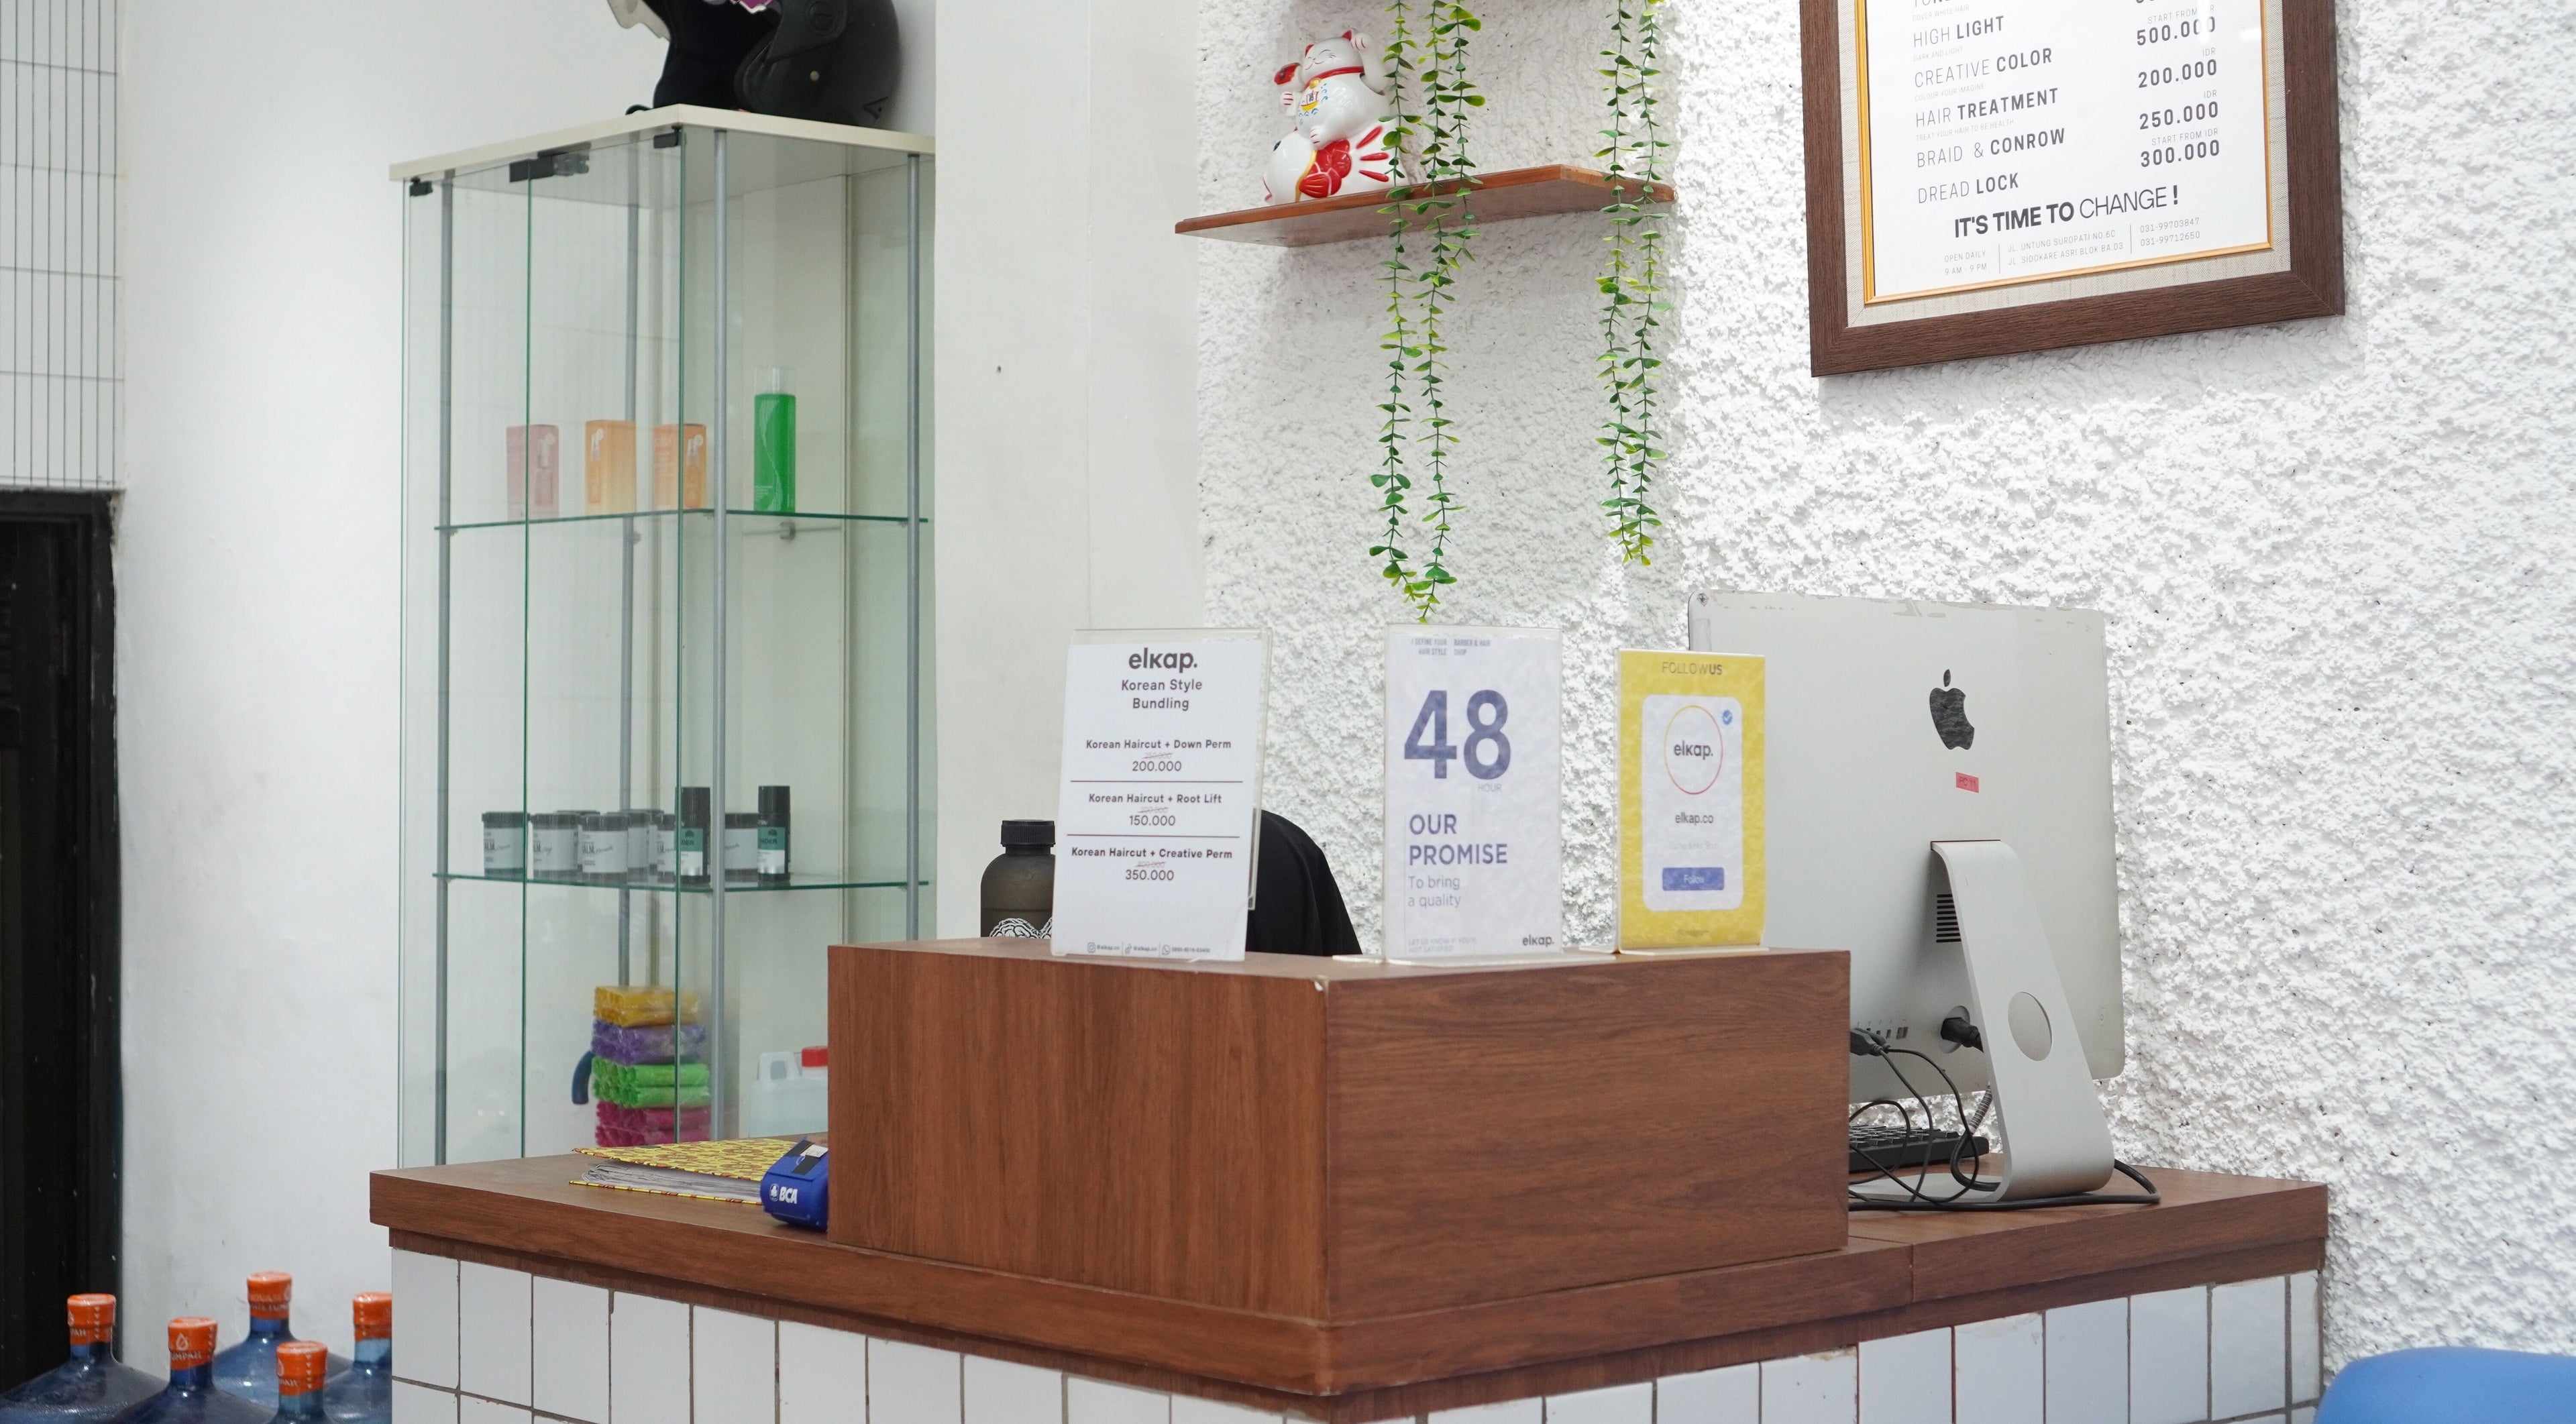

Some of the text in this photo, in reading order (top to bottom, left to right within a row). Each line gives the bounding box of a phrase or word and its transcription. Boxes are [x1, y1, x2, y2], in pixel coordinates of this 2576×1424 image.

[2148, 13, 2172, 24] START
[2176, 8, 2198, 19] FROM
[1913, 15, 2004, 48] HIGH LIGHT
[2202, 47, 2216, 56] IDR
[1915, 48, 2052, 88] CREATIVE COLOR
[2138, 58, 2216, 88] 200.000
[1915, 83, 1985, 102] COLOUR YOUR IMAGINE
[2204, 89, 2217, 99] IDR
[1916, 87, 2058, 128] HAIR TREATMENT
[2139, 101, 2218, 129] 250.000
[1916, 131, 1935, 142] TREAT
[1937, 128, 1953, 138] YOUR
[1954, 125, 1969, 136] HAIR
[1990, 118, 2015, 129] HEALTH
[2151, 128, 2218, 146] START FROM IDR
[1917, 127, 2065, 168] BRAID & CONROW
[2141, 140, 2219, 168] 300.000
[1918, 172, 2019, 204] DREAD LOCK
[1955, 215, 1988, 238] IT'S
[1993, 206, 2041, 231] TIME
[2046, 201, 2074, 223] TO
[2080, 186, 2167, 219] CHANGE
[2021, 239, 2051, 252] UNTUNG
[2053, 233, 2091, 248] SUROPATI
[1944, 249, 1986, 264] OPEN DAILY
[2021, 251, 2057, 264] SIDOKARE
[2060, 248, 2078, 260] ASRI
[2080, 245, 2099, 256] BLOK
[1945, 268, 1949, 276] 9
[1951, 264, 1962, 274] AM
[1970, 263, 1974, 273] 9
[1976, 262, 1987, 272] PM
[1128, 647, 1197, 673] elkap.
[1122, 679, 1202, 693] Korean Style
[1132, 698, 1189, 711] Bundling
[1404, 690, 1511, 779] 48
[1086, 740, 1120, 749] Korean
[1124, 740, 1161, 749] Haircut
[1174, 740, 1202, 749] Down
[1205, 740, 1231, 749] Perm
[1674, 740, 1713, 760] elkap.
[1132, 761, 1182, 771] 200.000
[1478, 783, 1502, 792] HOUR
[1089, 793, 1123, 803] Korean
[1127, 793, 1164, 803] Haircut
[1177, 794, 1201, 803] Root
[1204, 794, 1222, 804] Lift
[1129, 815, 1176, 826] 150.000
[1409, 814, 1457, 835] OUR
[1675, 812, 1713, 826] elkap.co
[1071, 847, 1106, 857] Korean
[1110, 848, 1146, 857] Haircut
[1159, 848, 1203, 859] Creative
[1206, 849, 1232, 859] Perm
[1409, 843, 1508, 865] PROMISE
[1126, 870, 1174, 881] 350.000
[1408, 875, 1460, 890] To bring
[1408, 893, 1461, 908] a quality
[1522, 934, 1554, 947] elkap.
[779, 1187, 798, 1204] BCA
